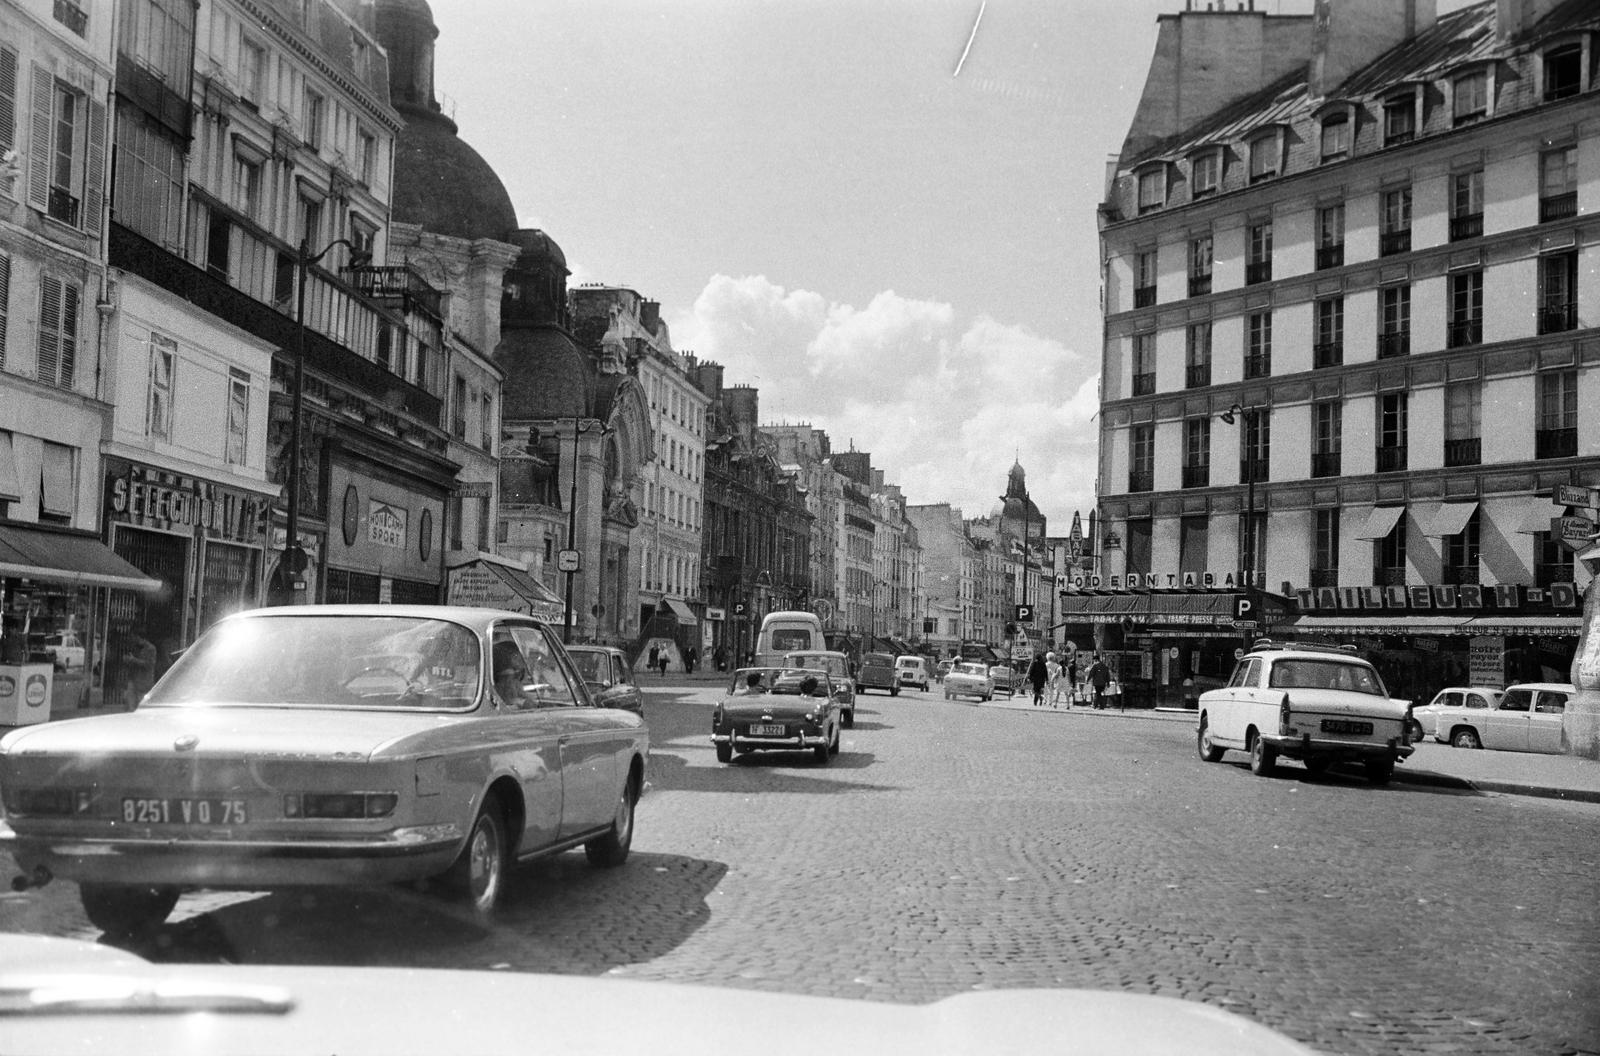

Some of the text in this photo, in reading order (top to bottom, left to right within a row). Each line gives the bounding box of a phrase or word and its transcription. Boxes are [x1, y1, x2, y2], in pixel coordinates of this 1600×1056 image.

[373, 527, 400, 546] SPORT
[1298, 584, 1482, 609] TAILLEUR
[1496, 584, 1518, 608] H
[1551, 583, 1576, 607] D
[736, 605, 744, 613] P
[1019, 608, 1029, 619] P
[1239, 600, 1251, 617] P
[124, 799, 169, 824] 8251
[221, 800, 246, 824] 75
